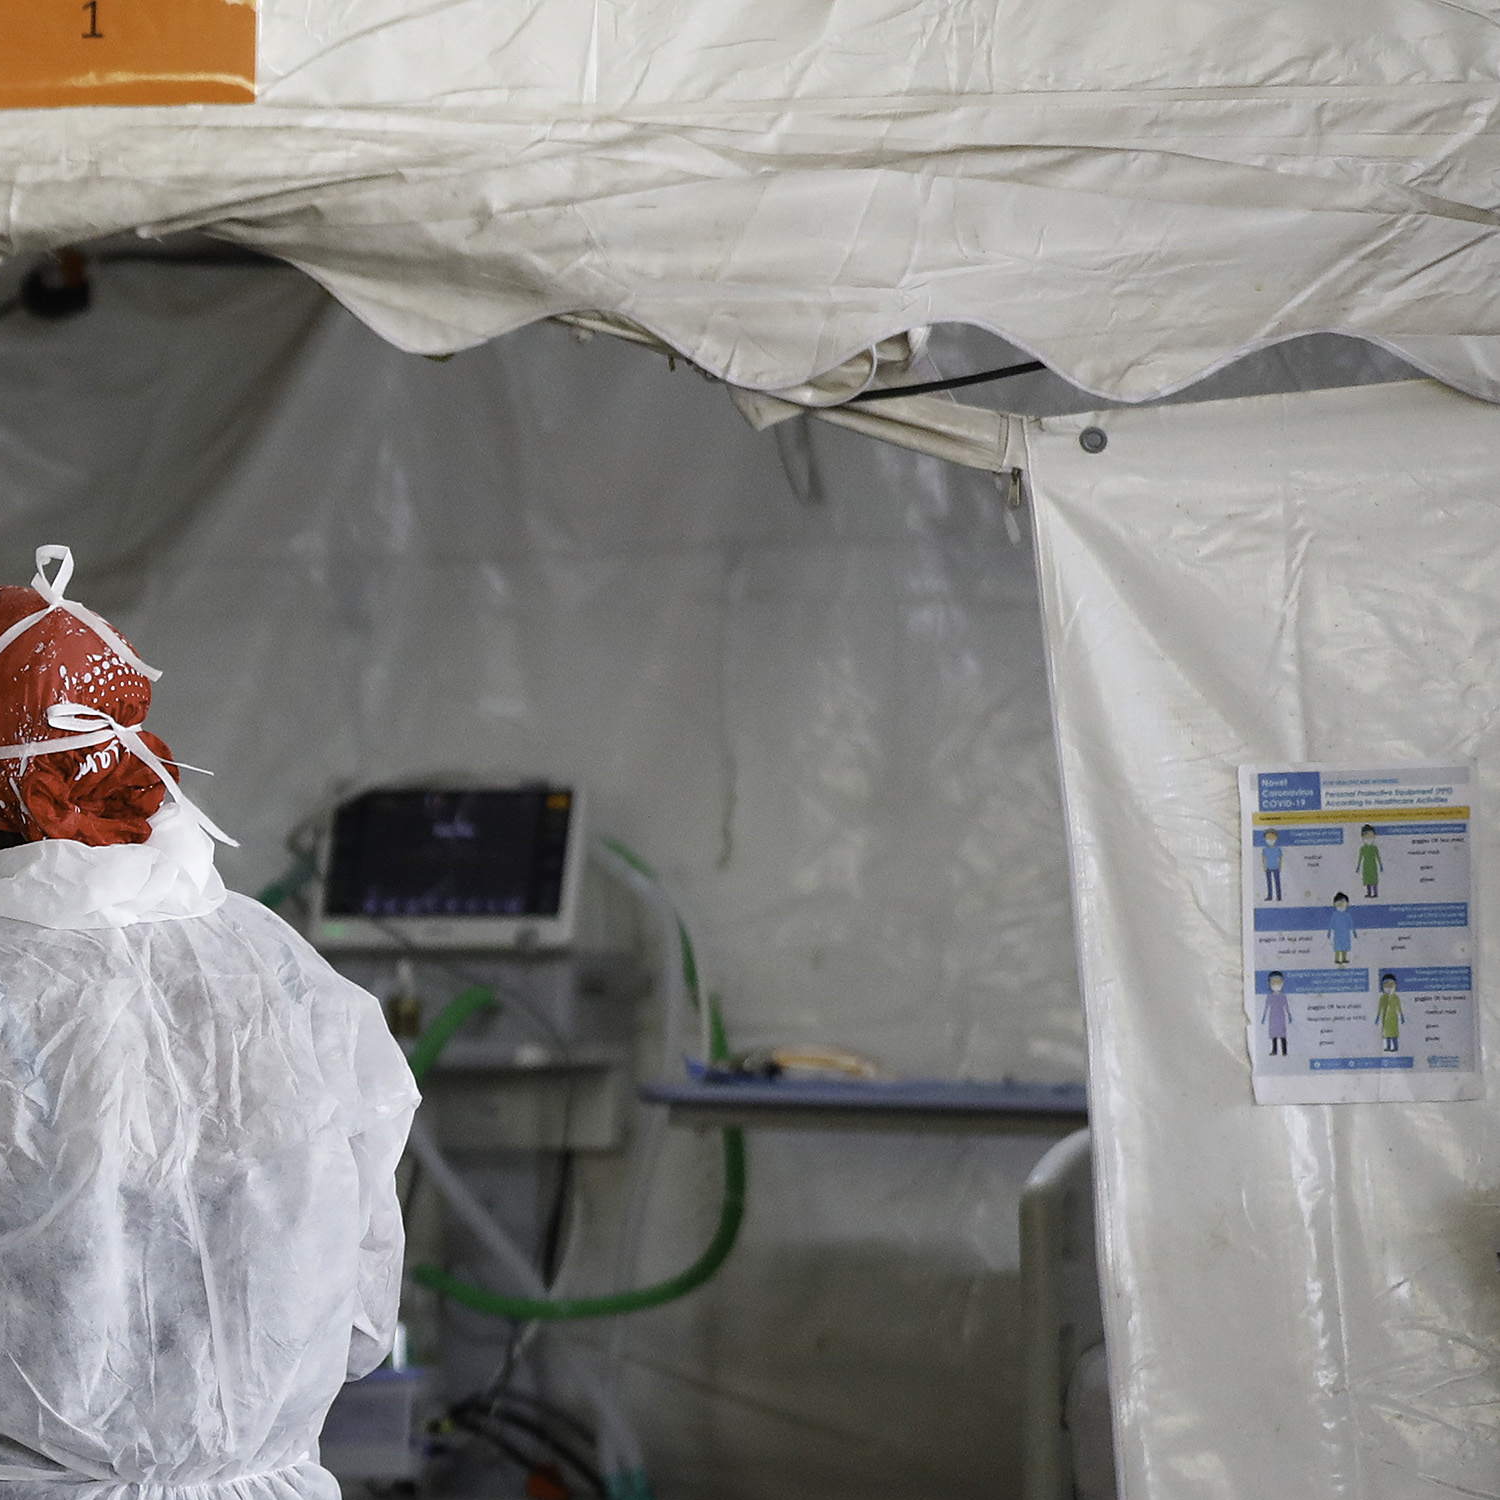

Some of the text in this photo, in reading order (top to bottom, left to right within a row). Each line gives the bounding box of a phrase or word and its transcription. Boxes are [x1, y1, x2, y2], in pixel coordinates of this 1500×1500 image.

[81, 0, 104, 39] 1
[1261, 777, 1288, 787] Novel
[1261, 788, 1314, 798] Coronavirus
[1261, 798, 1306, 809] COVID-19
